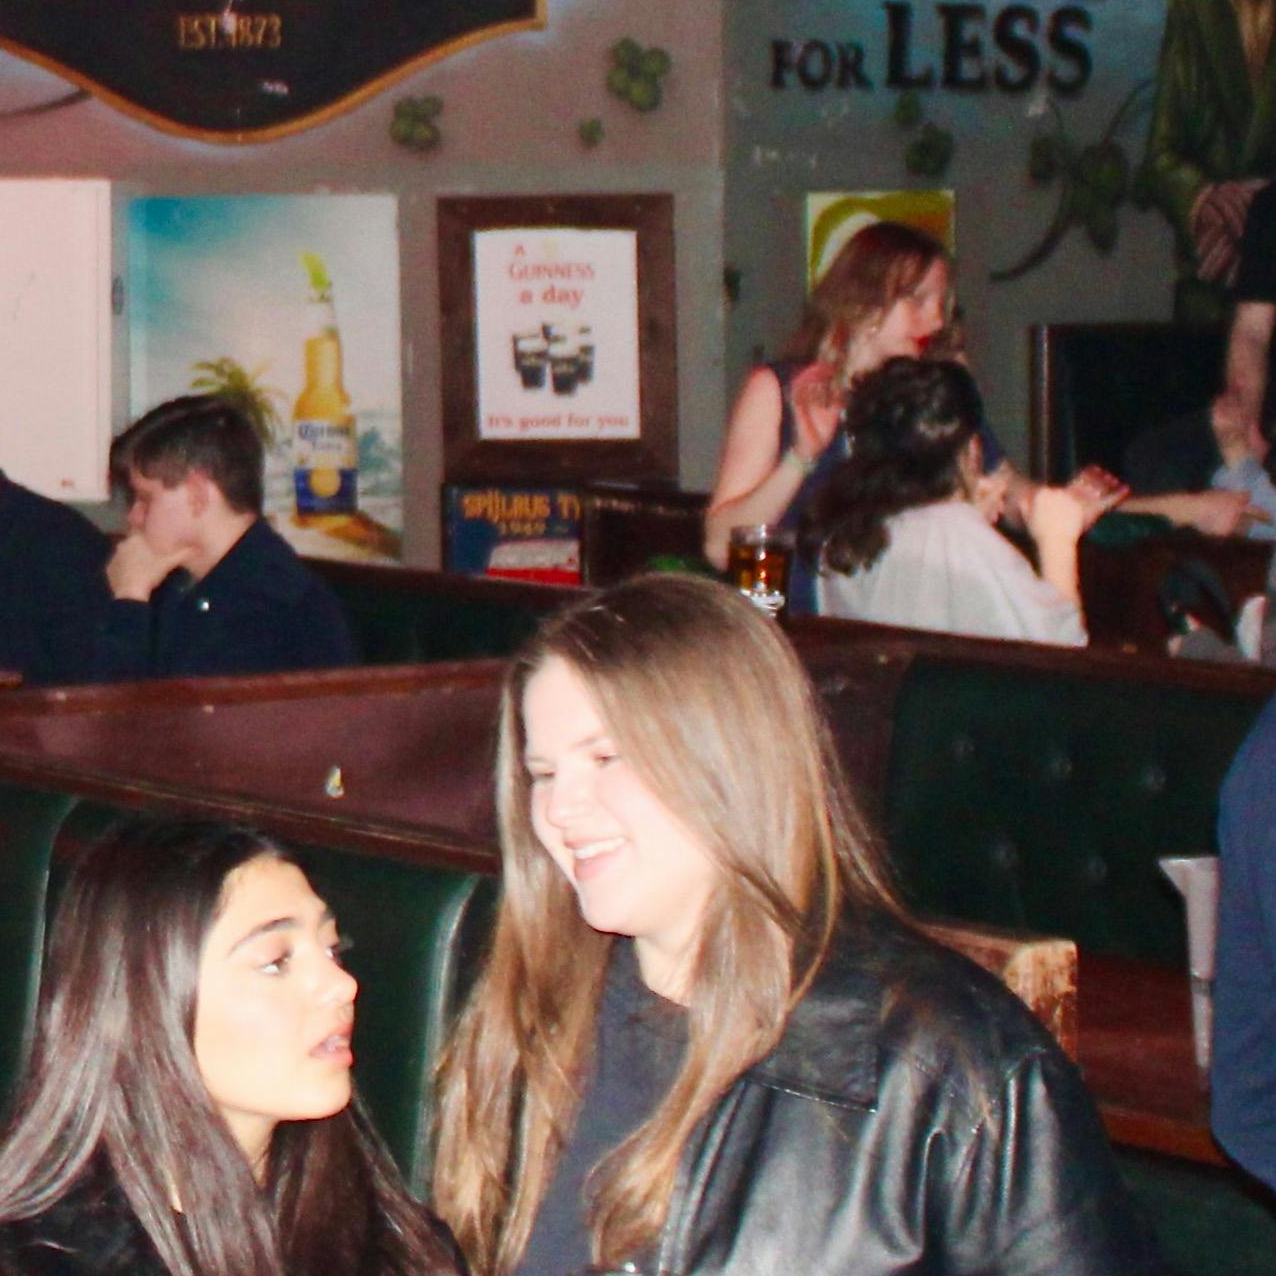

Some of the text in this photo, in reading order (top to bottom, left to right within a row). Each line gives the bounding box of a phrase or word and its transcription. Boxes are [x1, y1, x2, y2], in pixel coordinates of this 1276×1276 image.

[769, 1, 1095, 96] FOR LESS
[508, 262, 596, 281] GUINNESS
[542, 284, 584, 309] day
[519, 414, 562, 432] good
[567, 413, 590, 428] for
[597, 415, 629, 431] you
